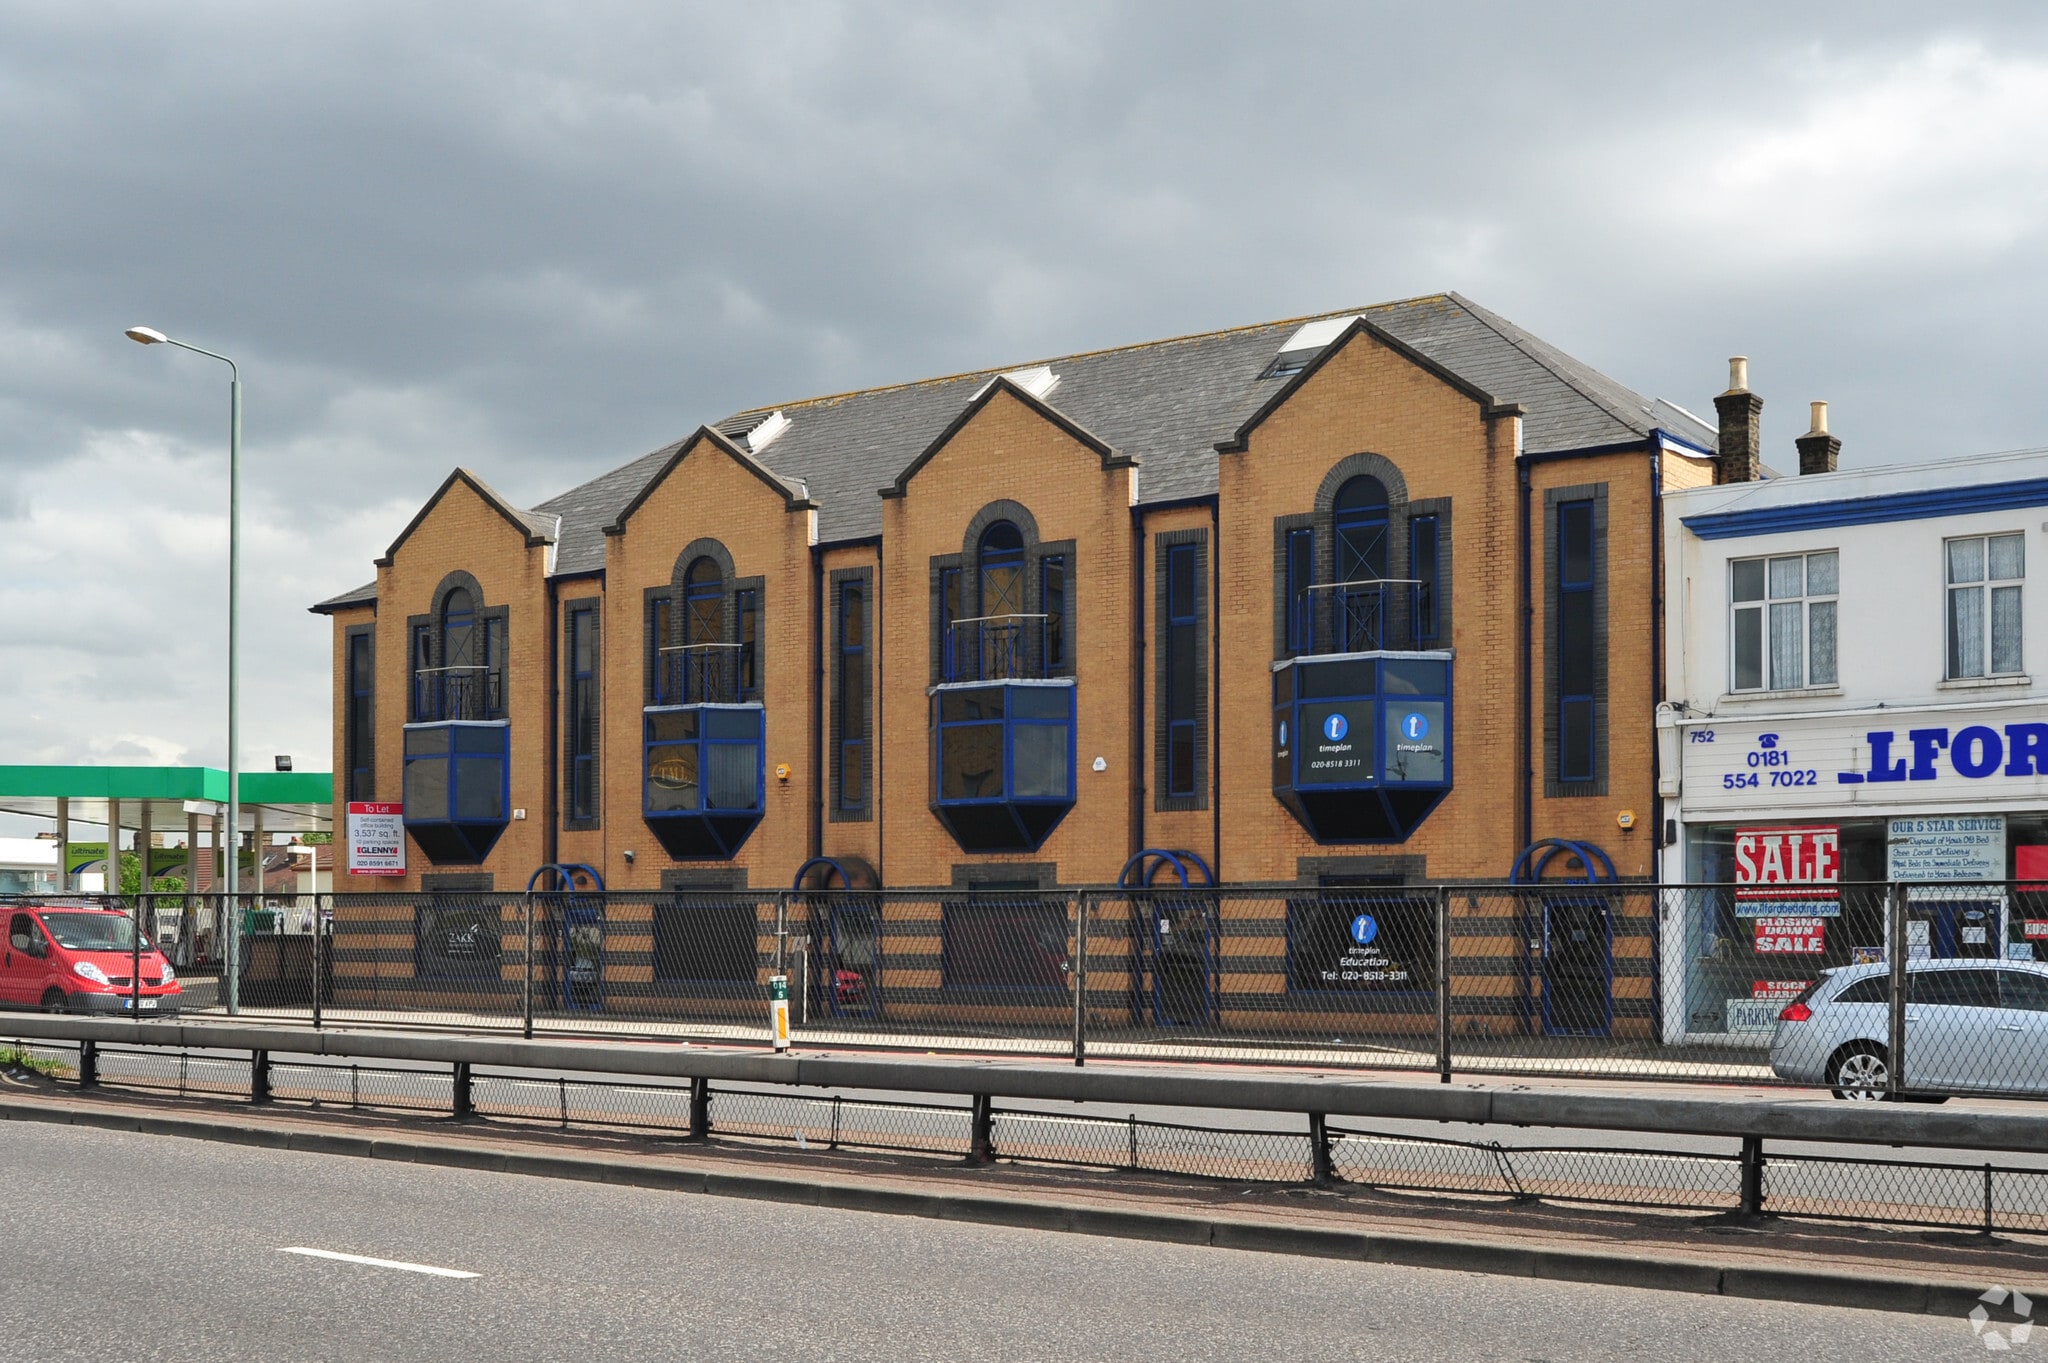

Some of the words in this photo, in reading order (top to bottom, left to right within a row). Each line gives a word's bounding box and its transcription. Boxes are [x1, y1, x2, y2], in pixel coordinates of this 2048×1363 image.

[1690, 731, 1715, 743] 752
[1319, 744, 1352, 753] timeplan
[1397, 743, 1433, 753] timeplan
[1747, 751, 1789, 767] 0181
[1723, 773, 1759, 789] 554
[1770, 770, 1817, 787] 7022
[364, 804, 374, 813] To
[376, 804, 389, 813] Let
[1892, 821, 1914, 833] OUR
[1917, 820, 1924, 832] 5
[1927, 819, 1955, 832] STAR
[1958, 818, 2002, 831] SERVICE
[354, 829, 376, 838] 3,537
[1976, 835, 1989, 844] Bed
[361, 846, 394, 854] GLENNY
[1912, 848, 1932, 856] Local
[1935, 847, 1970, 857] Delivery
[1736, 834, 1838, 888] SALE
[1756, 918, 1823, 926] CLOSING
[1765, 927, 1814, 935] DOWN
[1756, 937, 1823, 952] SALE
[1340, 957, 1389, 966] Education
